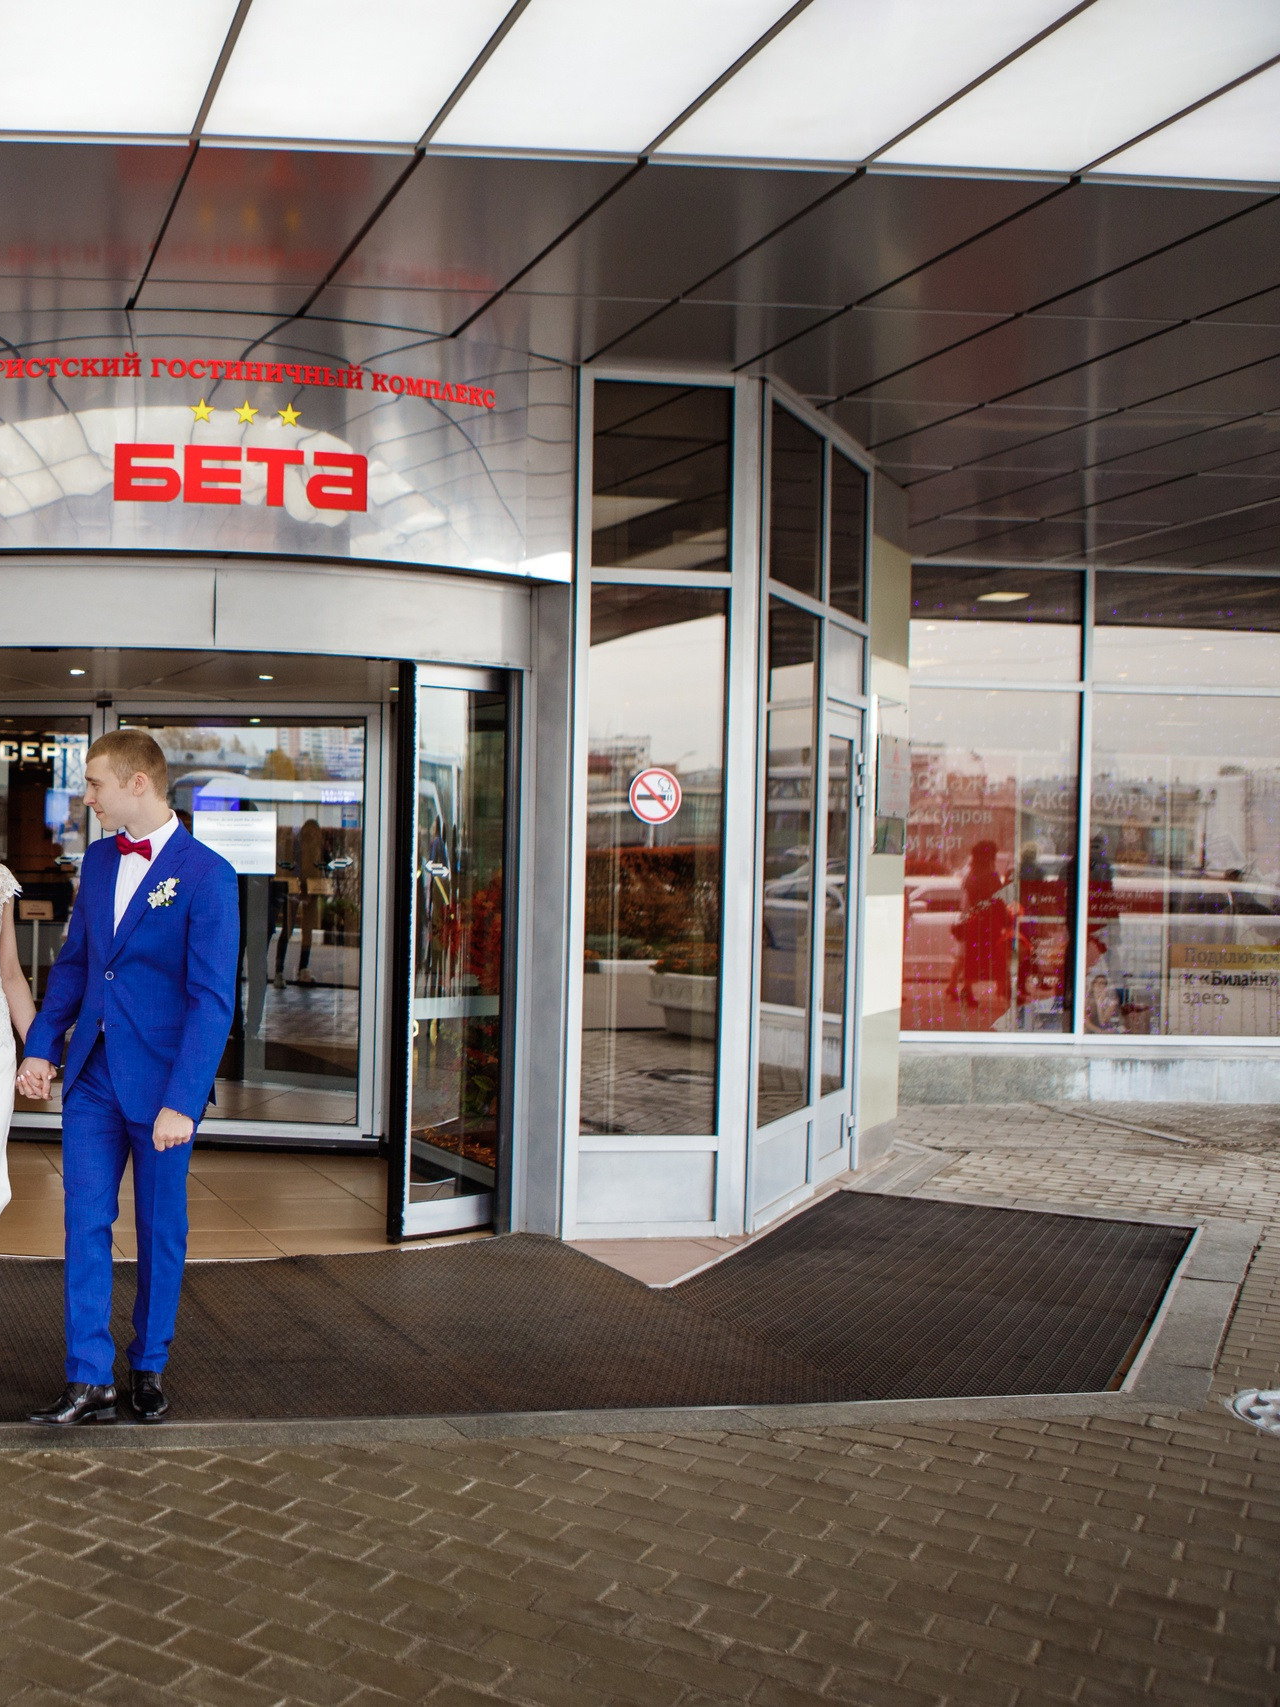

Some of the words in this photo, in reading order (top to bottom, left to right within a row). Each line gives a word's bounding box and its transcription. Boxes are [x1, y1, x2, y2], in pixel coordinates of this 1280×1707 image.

[151, 358, 364, 390] ГОСТИНИЧНЫЙ
[371, 373, 496, 410] КОМПЛЕКС
[1182, 991, 1230, 1007] здесь
